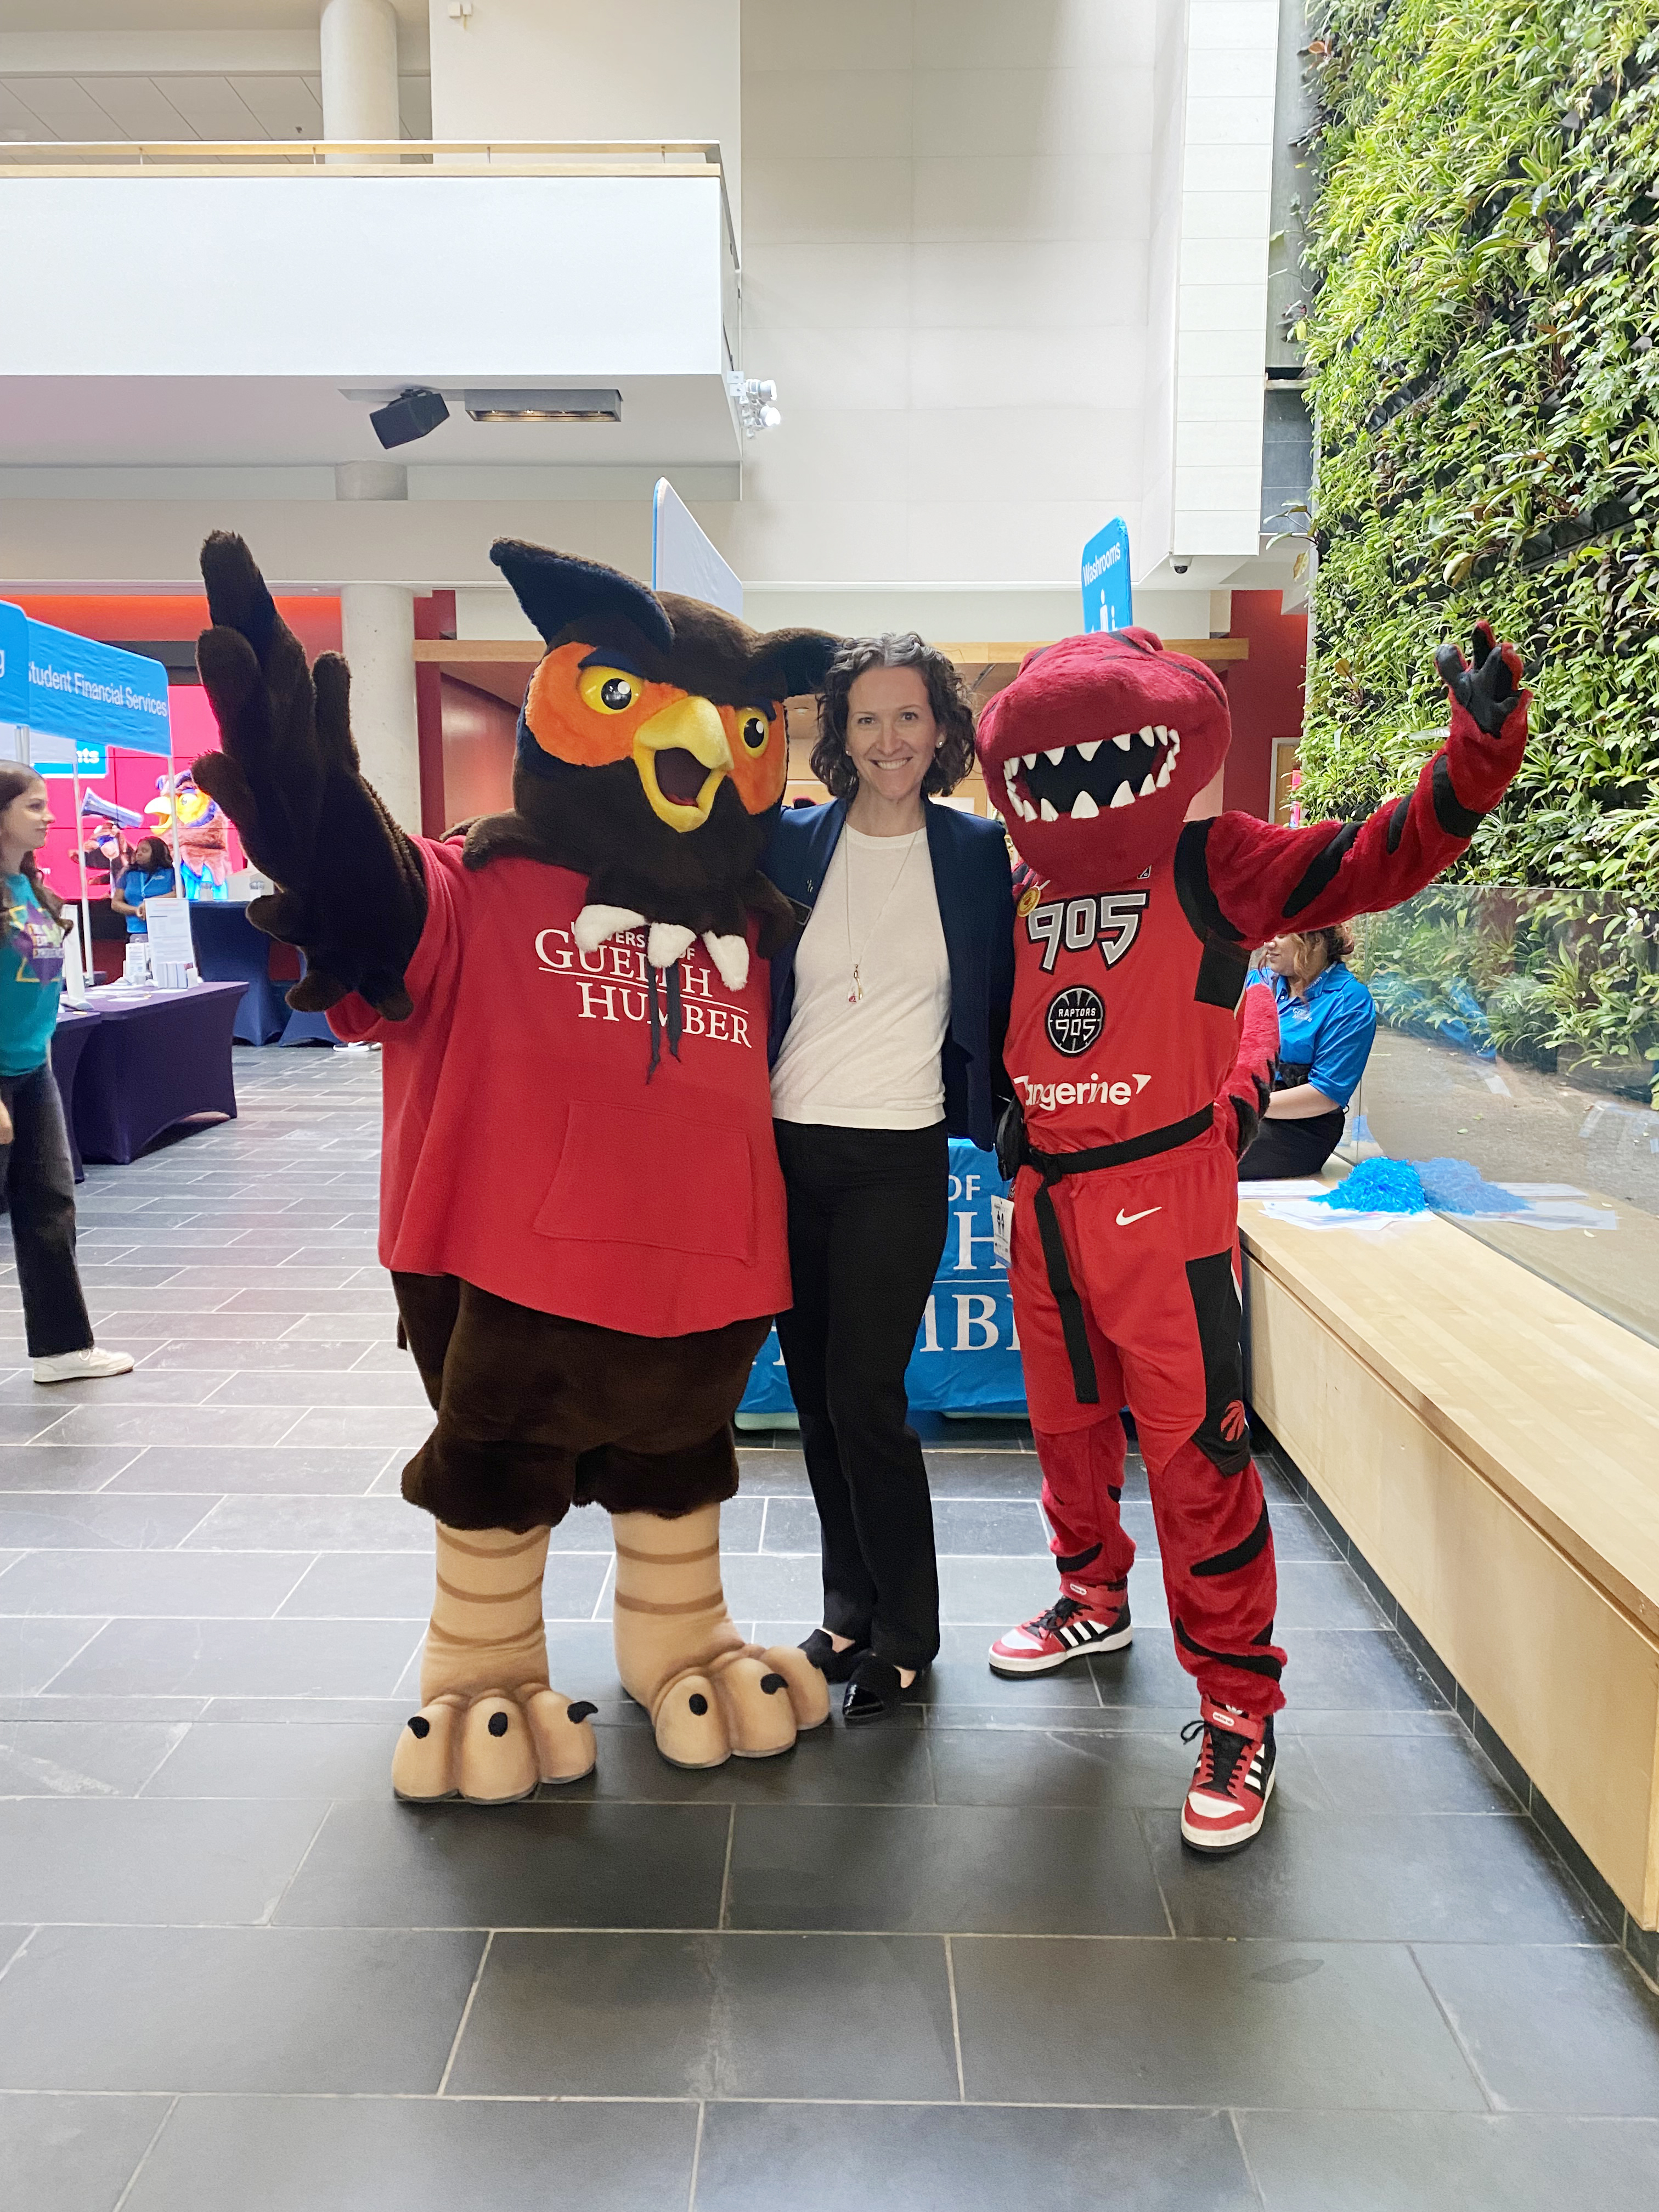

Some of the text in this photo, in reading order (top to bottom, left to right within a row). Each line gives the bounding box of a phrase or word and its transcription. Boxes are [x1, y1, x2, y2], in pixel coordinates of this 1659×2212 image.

[1083, 542, 1121, 586] Washrooms
[75, 674, 123, 707] Financial
[126, 687, 167, 717] Services
[1027, 893, 1147, 971] 905
[1055, 1019, 1097, 1042] 905
[1058, 1008, 1096, 1017] RAPTORS
